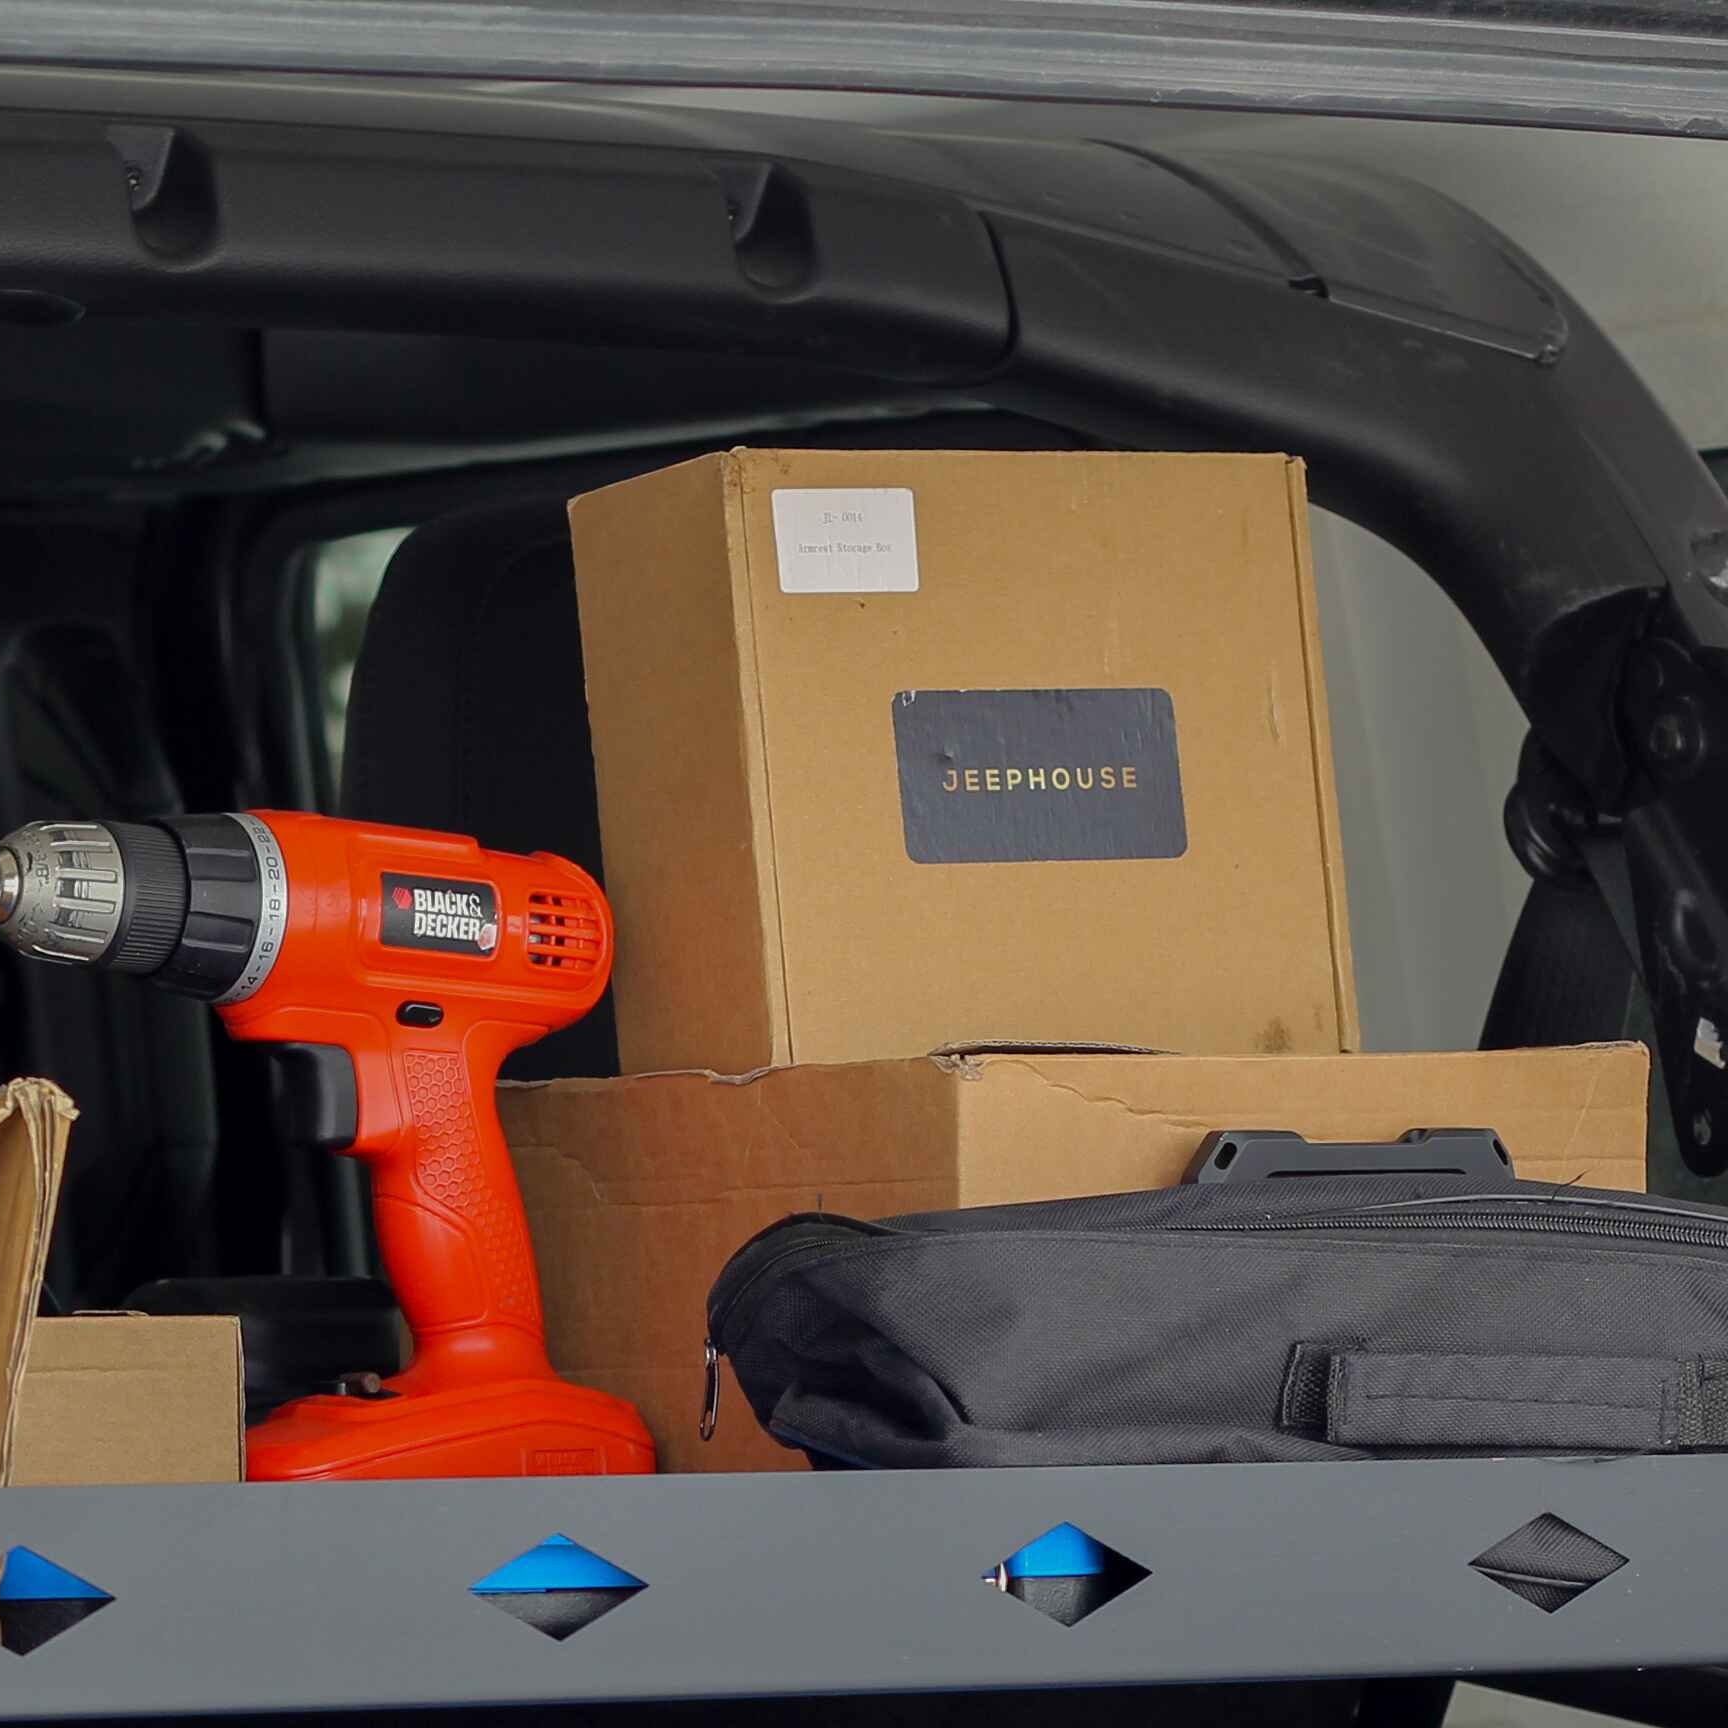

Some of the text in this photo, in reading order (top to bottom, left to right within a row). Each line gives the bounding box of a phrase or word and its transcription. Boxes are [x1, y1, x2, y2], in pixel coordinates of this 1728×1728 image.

[941, 765, 1139, 793] JEEPHOUSE
[265, 856, 282, 881] 20
[268, 899, 281, 920] 18
[413, 912, 481, 941] DECKER
[258, 941, 274, 961] 16
